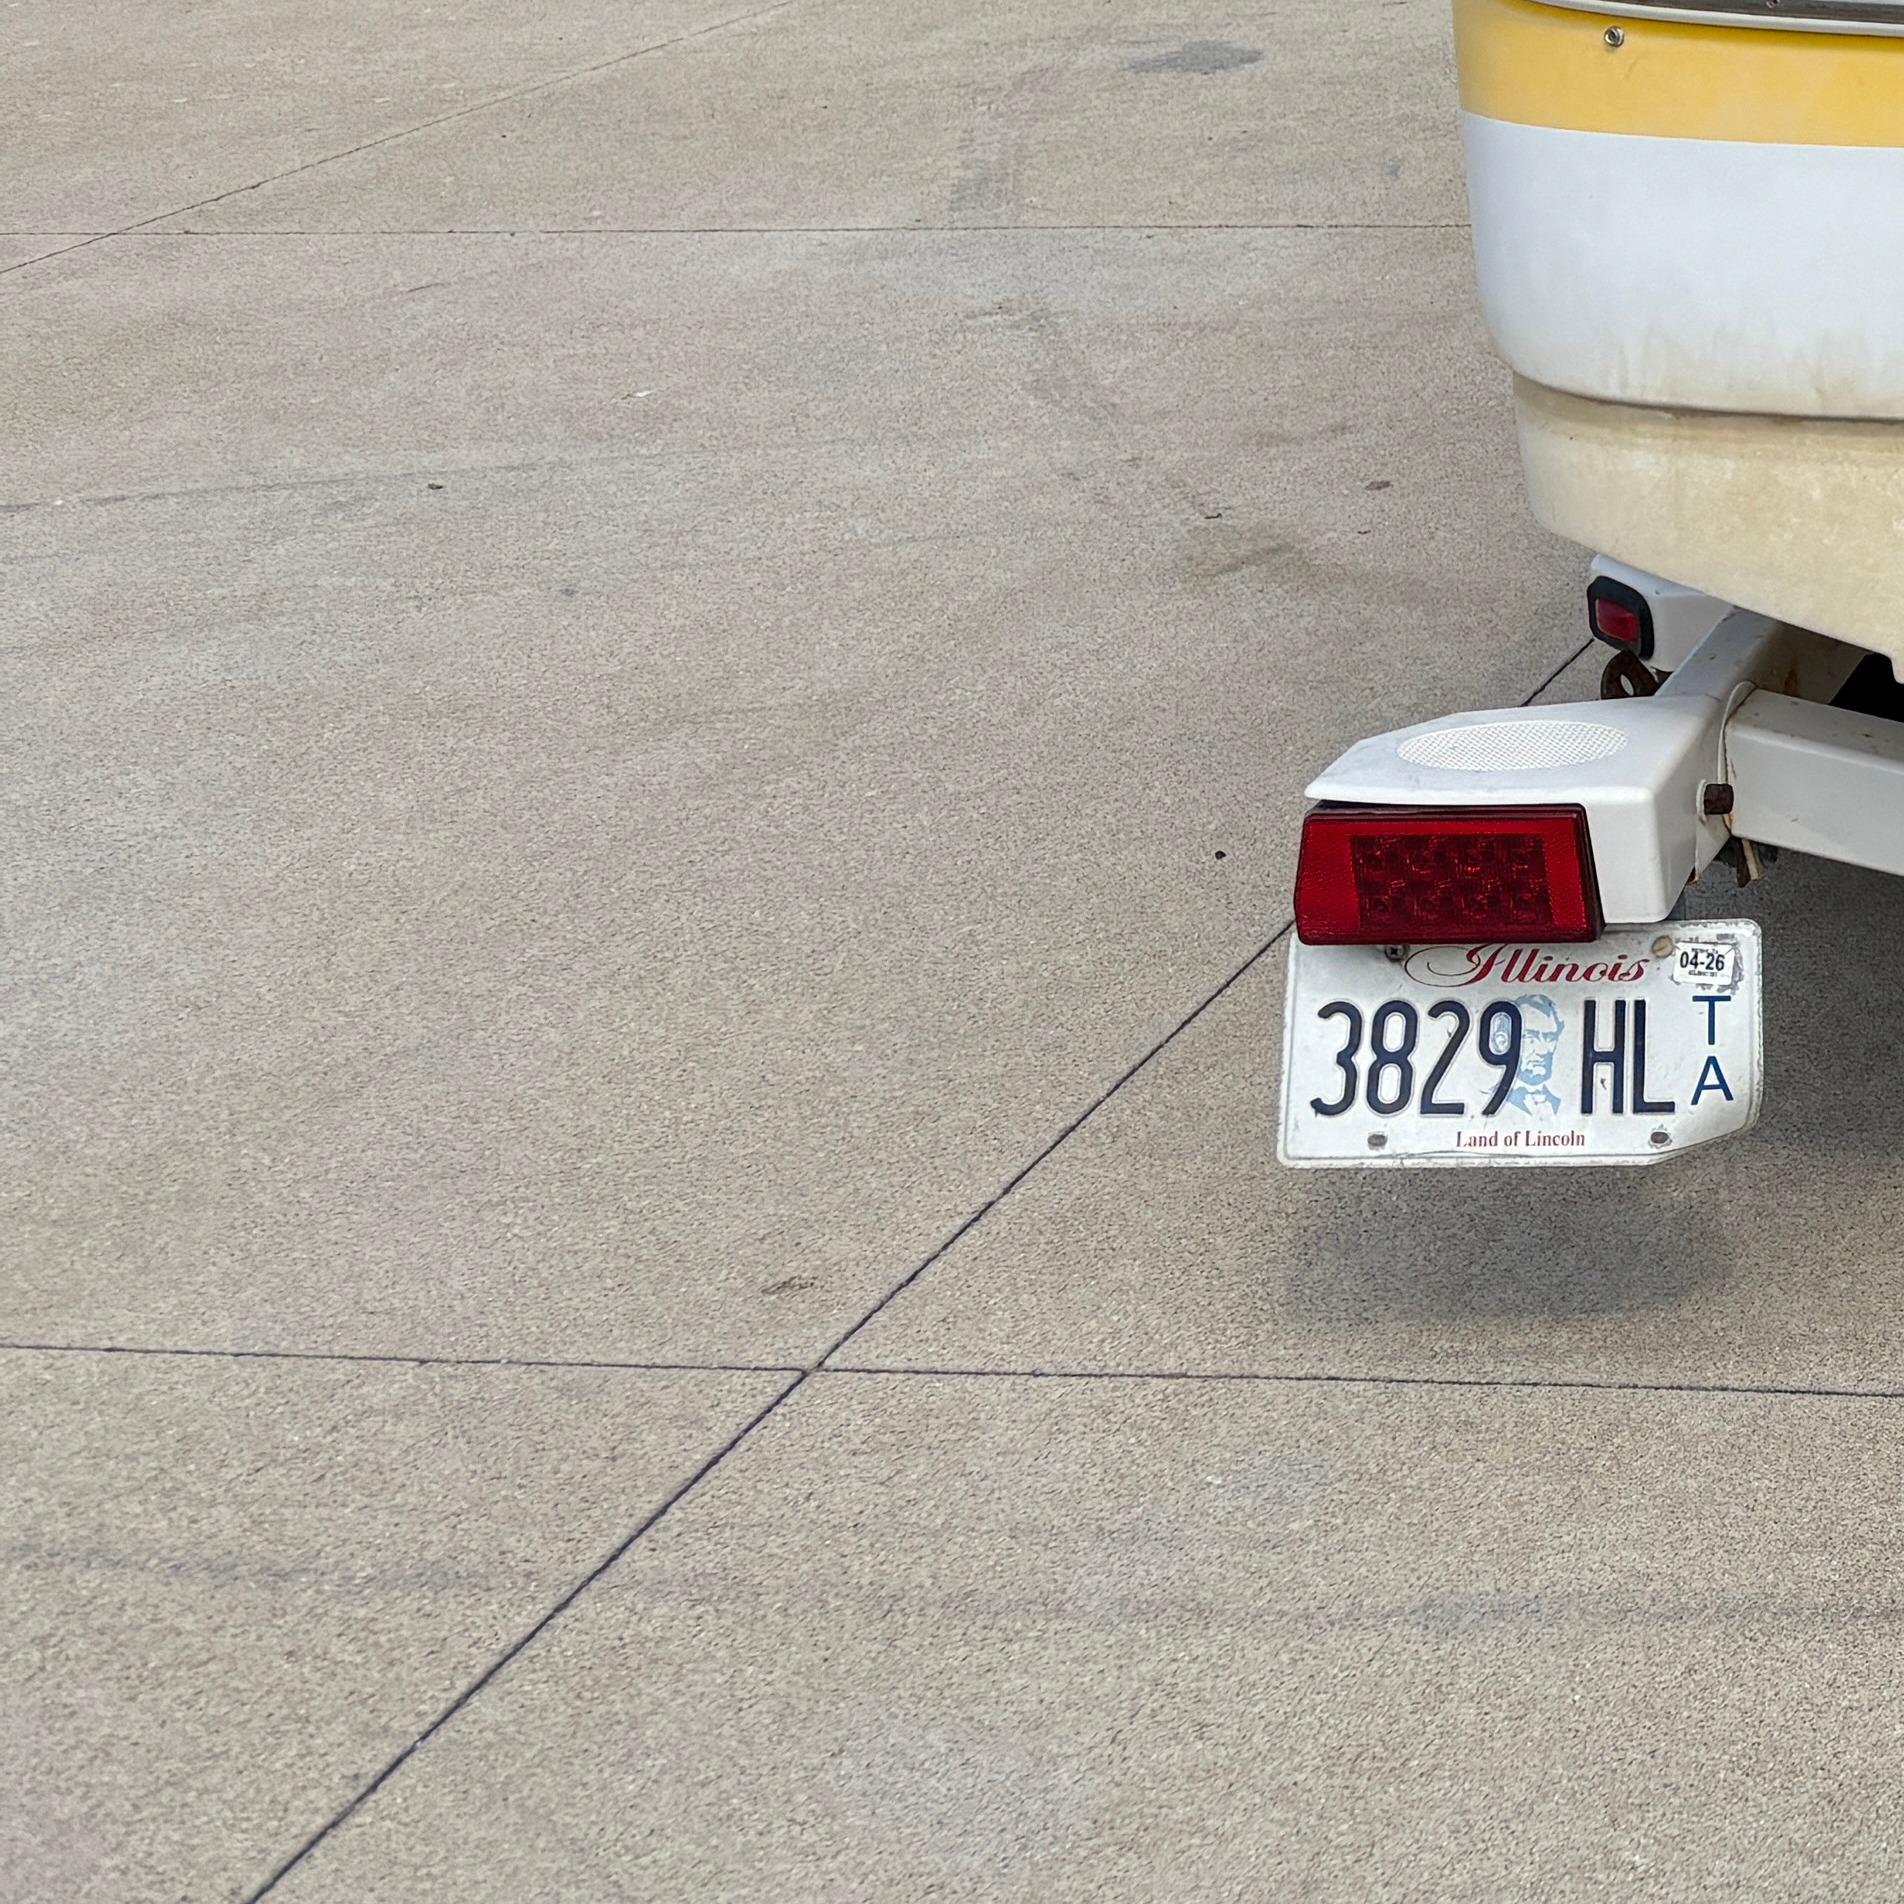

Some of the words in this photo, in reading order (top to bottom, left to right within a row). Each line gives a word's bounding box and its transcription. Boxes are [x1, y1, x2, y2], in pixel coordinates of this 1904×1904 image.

[1404, 942, 1650, 988] Illinois
[1679, 951, 1726, 972] 04-26
[1309, 998, 1524, 1117] 3829
[1580, 999, 1677, 1115] HL
[1455, 1130, 1499, 1148] Land
[1503, 1130, 1522, 1148] of
[1525, 1129, 1586, 1148] Lincoln
